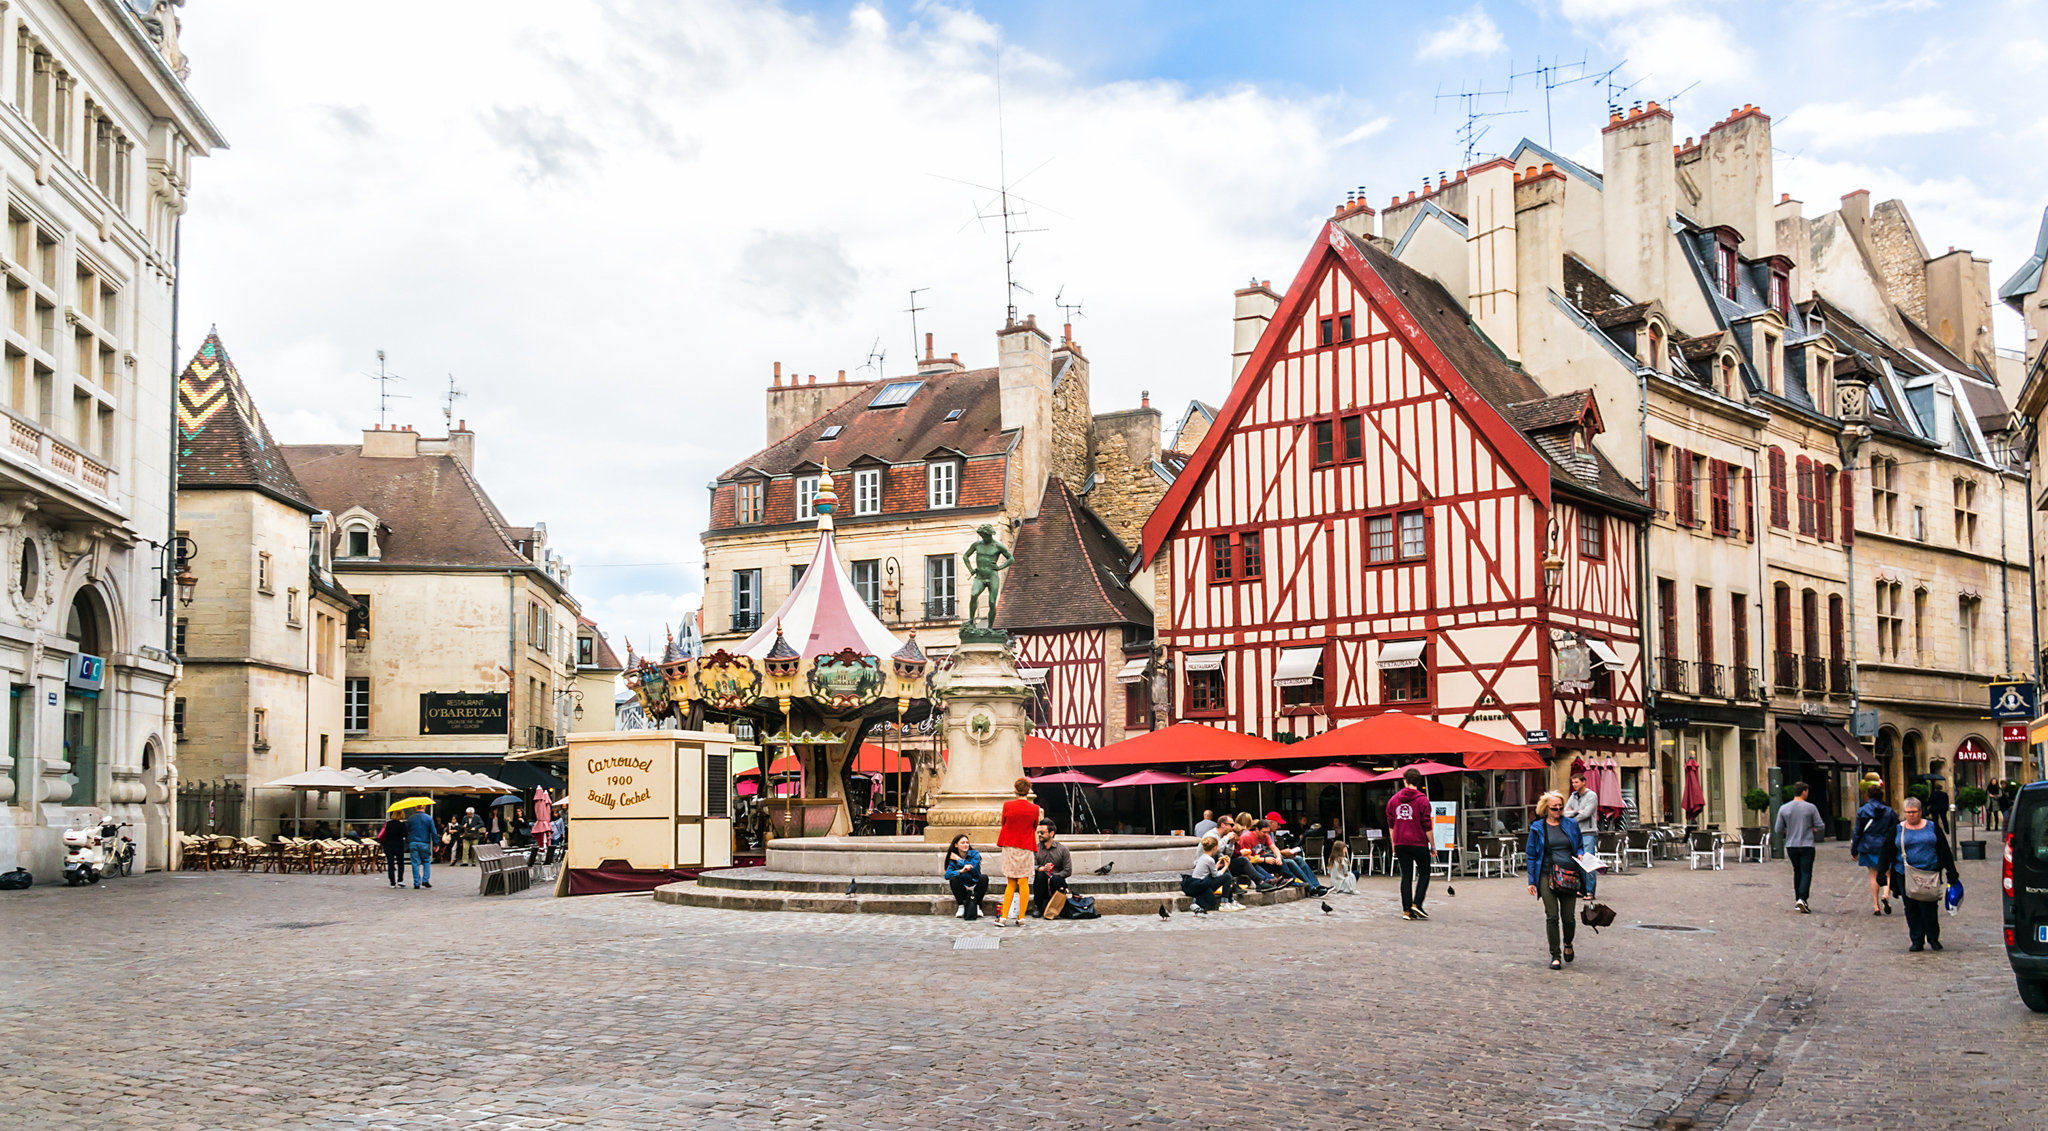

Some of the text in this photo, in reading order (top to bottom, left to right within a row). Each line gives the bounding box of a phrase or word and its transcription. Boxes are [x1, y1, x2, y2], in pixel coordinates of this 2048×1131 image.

[82, 660, 100, 677] CIC
[429, 707, 502, 718] O'BAREUZAI
[1958, 751, 1987, 760] BAYARD
[587, 757, 653, 774] Carrousel
[607, 775, 633, 786] 1900
